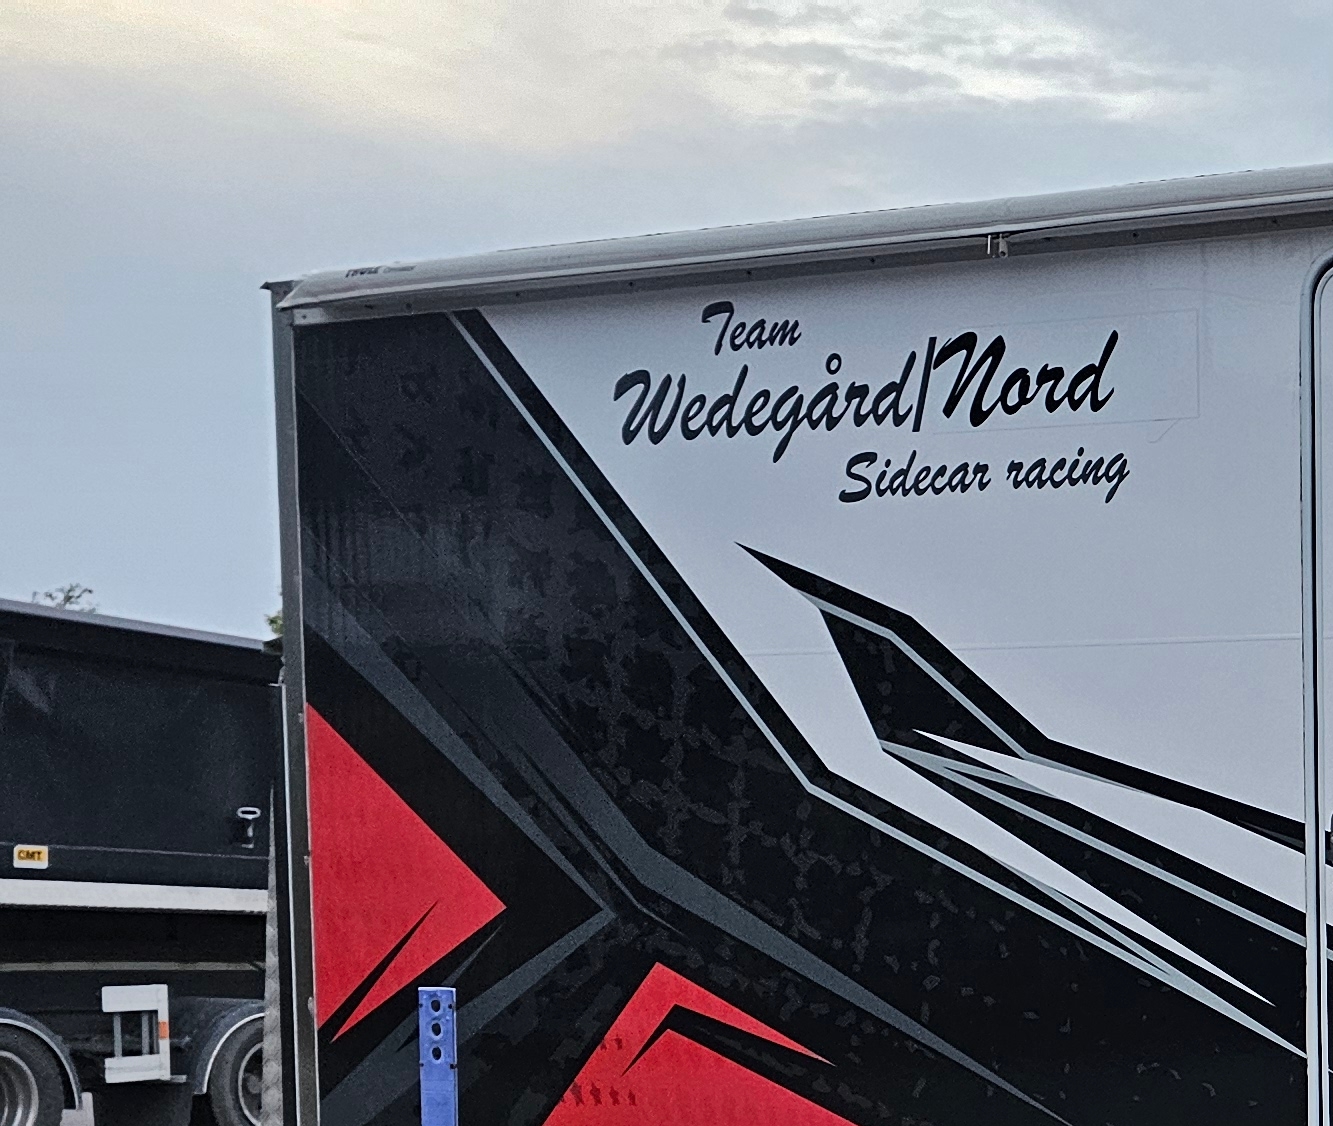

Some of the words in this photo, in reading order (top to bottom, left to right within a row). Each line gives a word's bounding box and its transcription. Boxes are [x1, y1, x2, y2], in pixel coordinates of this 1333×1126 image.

[700, 300, 802, 356] Team
[837, 449, 992, 504] Sidecar
[1005, 446, 1131, 504] racing
